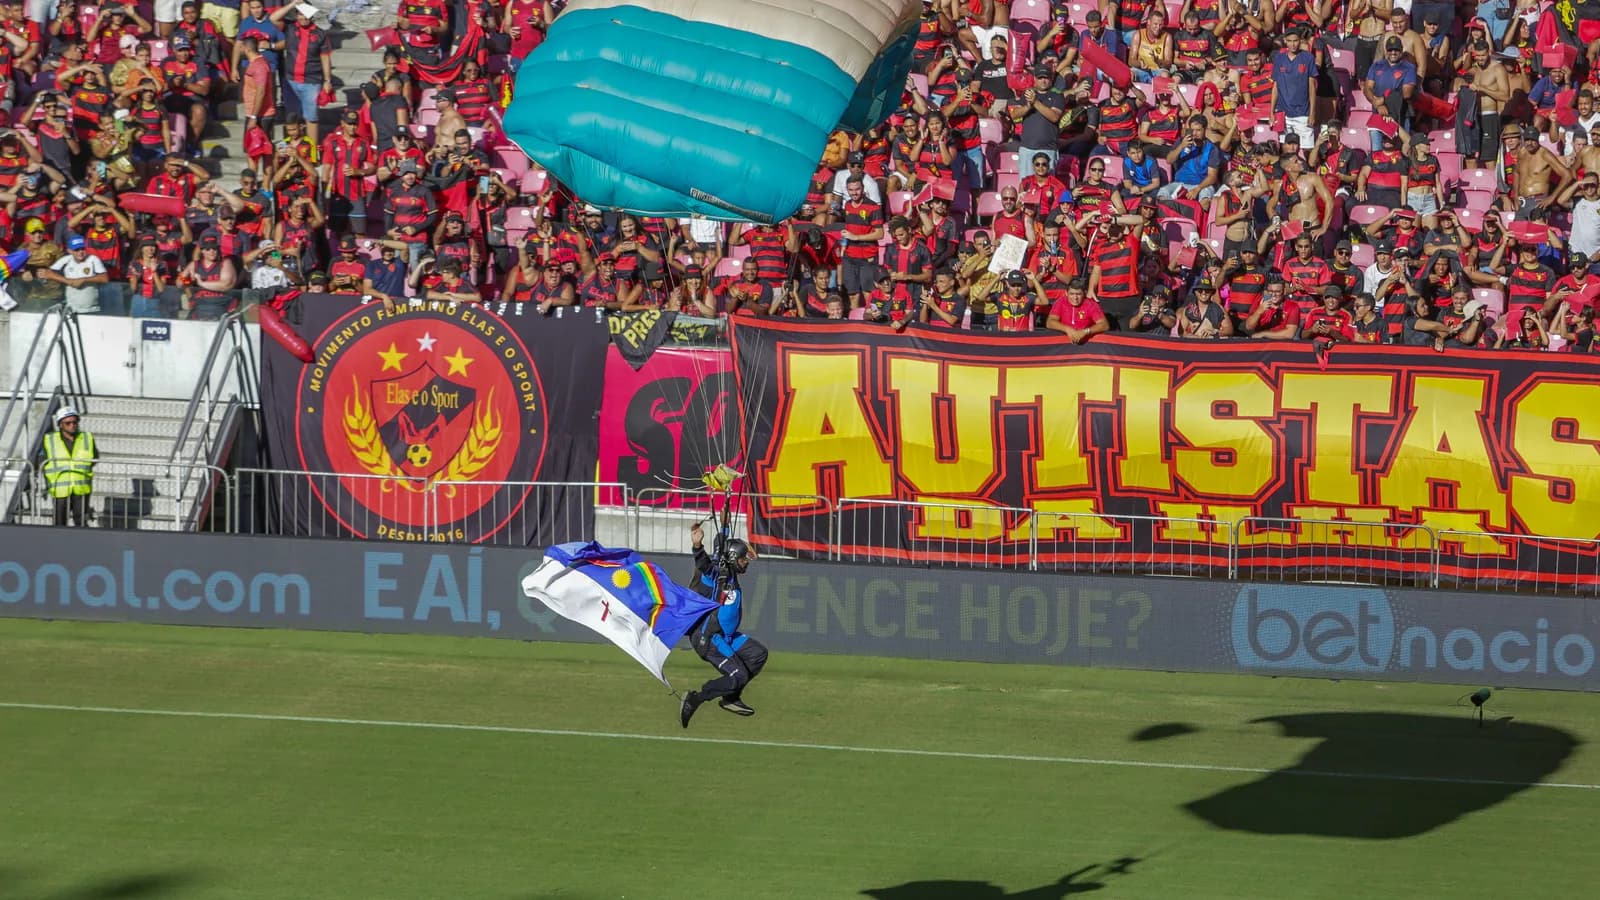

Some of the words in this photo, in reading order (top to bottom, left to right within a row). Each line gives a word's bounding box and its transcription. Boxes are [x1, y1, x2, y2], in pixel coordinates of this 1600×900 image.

[310, 316, 371, 392] MOVIMENTO
[461, 310, 495, 336] ELAS
[495, 335, 506, 346] E
[505, 348, 515, 358] O
[513, 363, 535, 411] SPORT
[386, 382, 409, 405] Elas
[412, 390, 419, 406] e
[421, 390, 429, 406] o
[431, 384, 459, 413] Sport
[764, 348, 1600, 541] AUTISTAS
[0, 550, 310, 614] onal.com
[959, 584, 1153, 656] HOJE?
